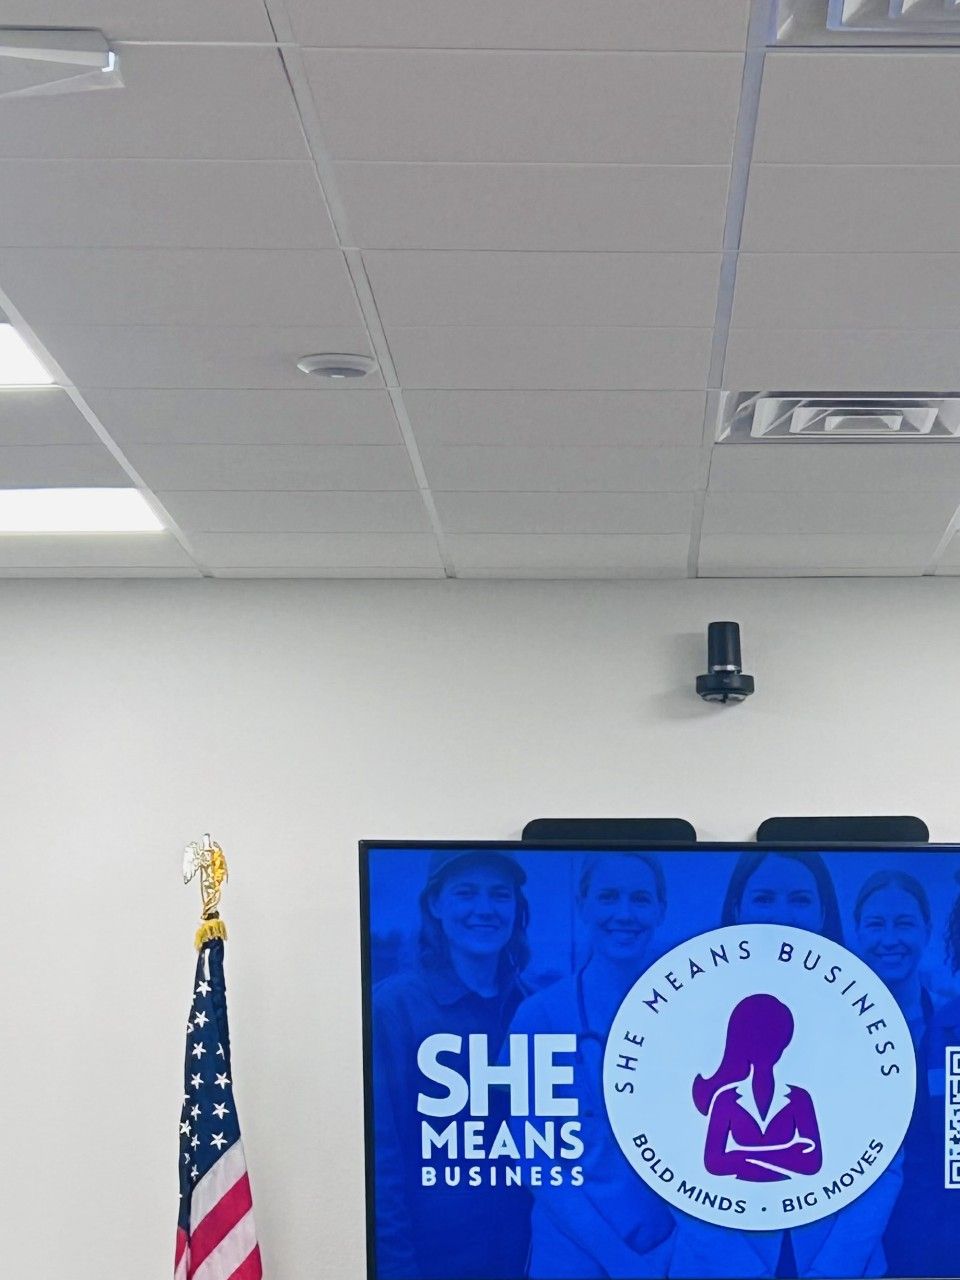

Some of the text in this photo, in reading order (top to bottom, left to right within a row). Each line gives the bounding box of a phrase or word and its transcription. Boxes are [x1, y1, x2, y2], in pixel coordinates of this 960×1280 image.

[614, 940, 900, 1094] SHE MEANS BUSINESS
[417, 1033, 579, 1117] SHE
[421, 1120, 584, 1160] MEANS
[421, 1166, 585, 1186] BUSINESS
[632, 1133, 884, 1214] BOLD MINDS BIG MOVES
